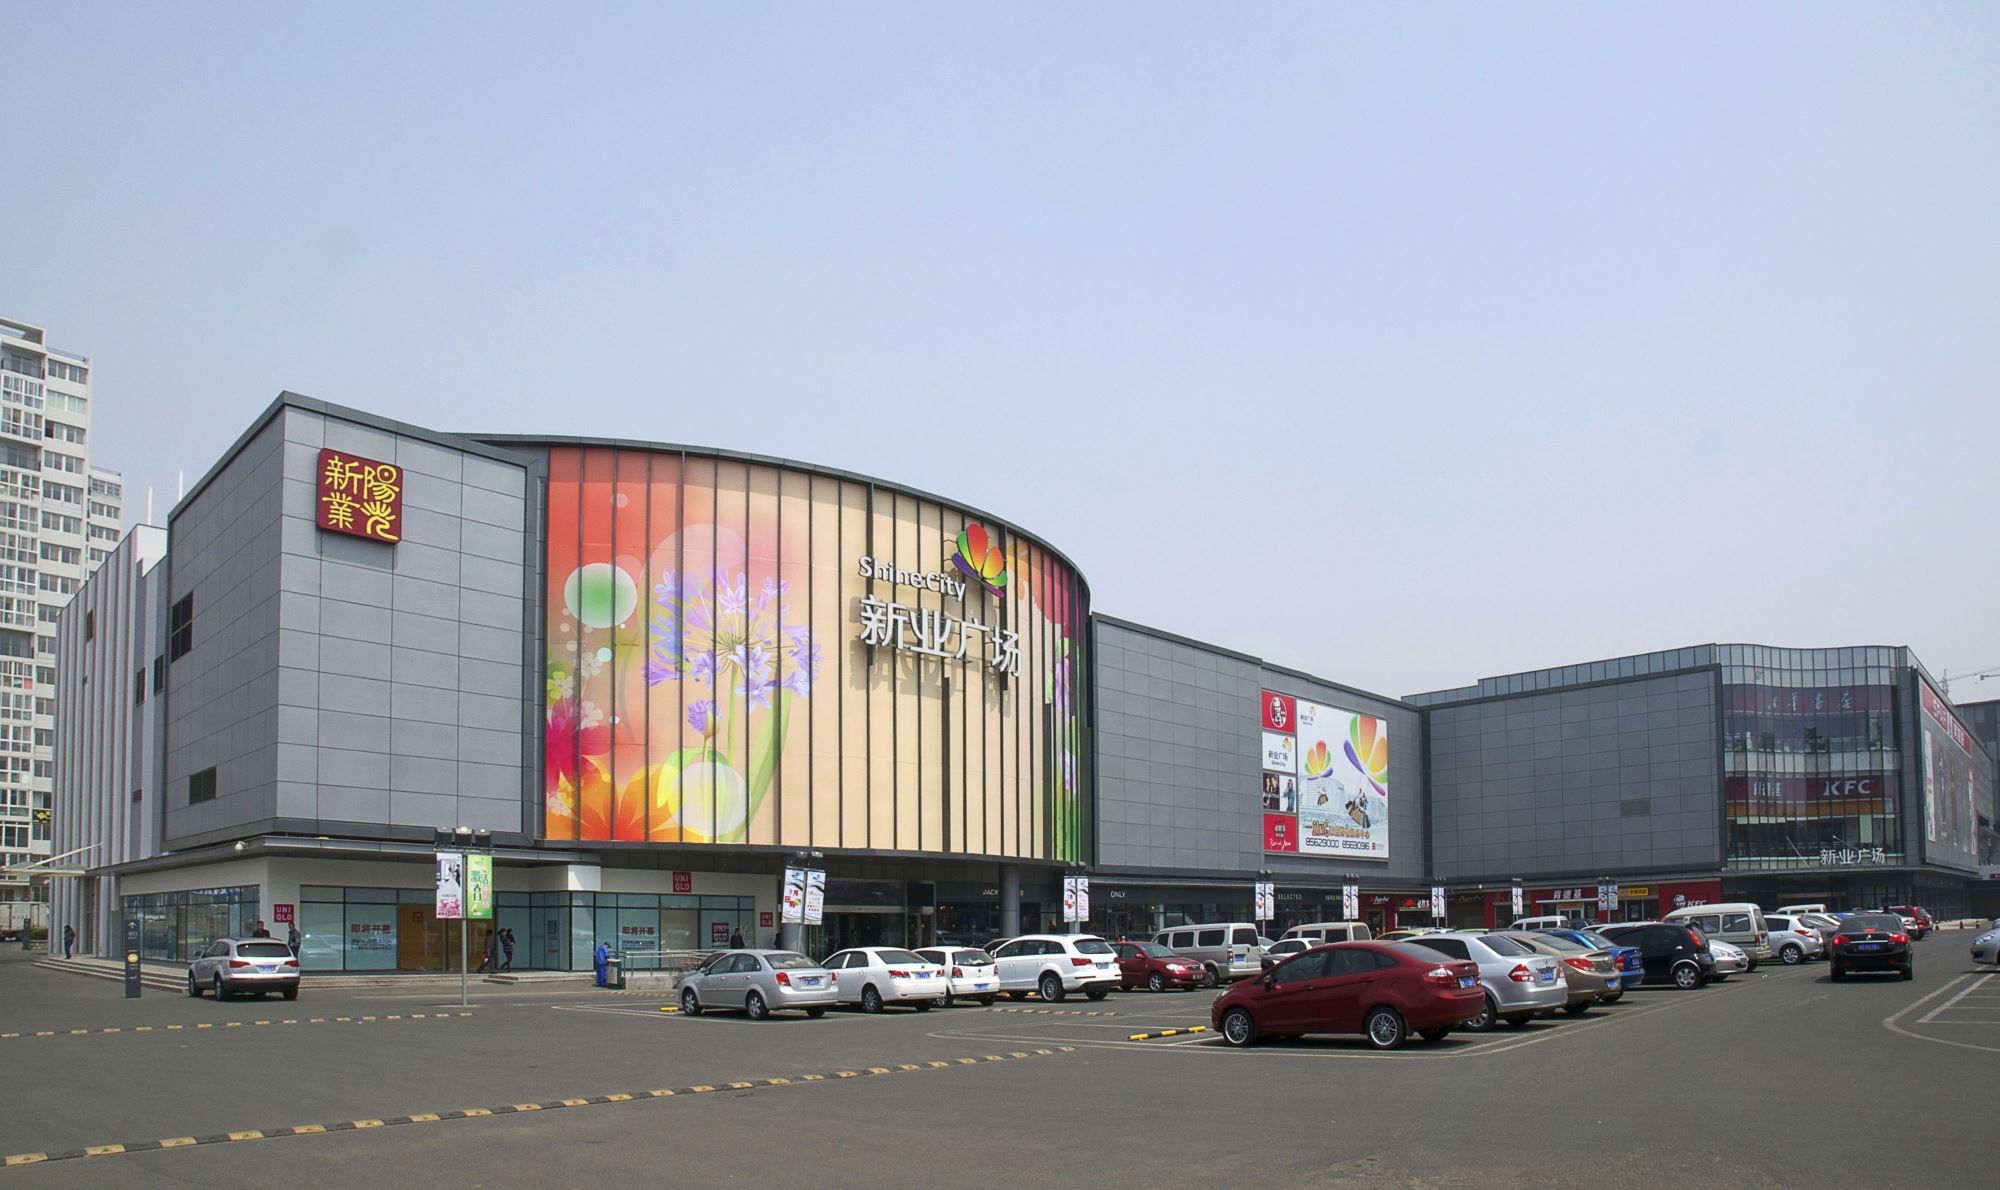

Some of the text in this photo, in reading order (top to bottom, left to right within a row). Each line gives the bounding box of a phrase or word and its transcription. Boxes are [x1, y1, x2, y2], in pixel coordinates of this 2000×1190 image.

[859, 556, 966, 601] Shine City
[860, 594, 1022, 677] 新业广场
[1268, 749, 1289, 762] 新业广场
[1823, 779, 1872, 796] KFC
[1819, 848, 1888, 865] 新业广场
[675, 874, 689, 882] UNI
[675, 883, 690, 891] QLO
[1110, 890, 1126, 898] ONLY
[276, 914, 293, 922] QLO
